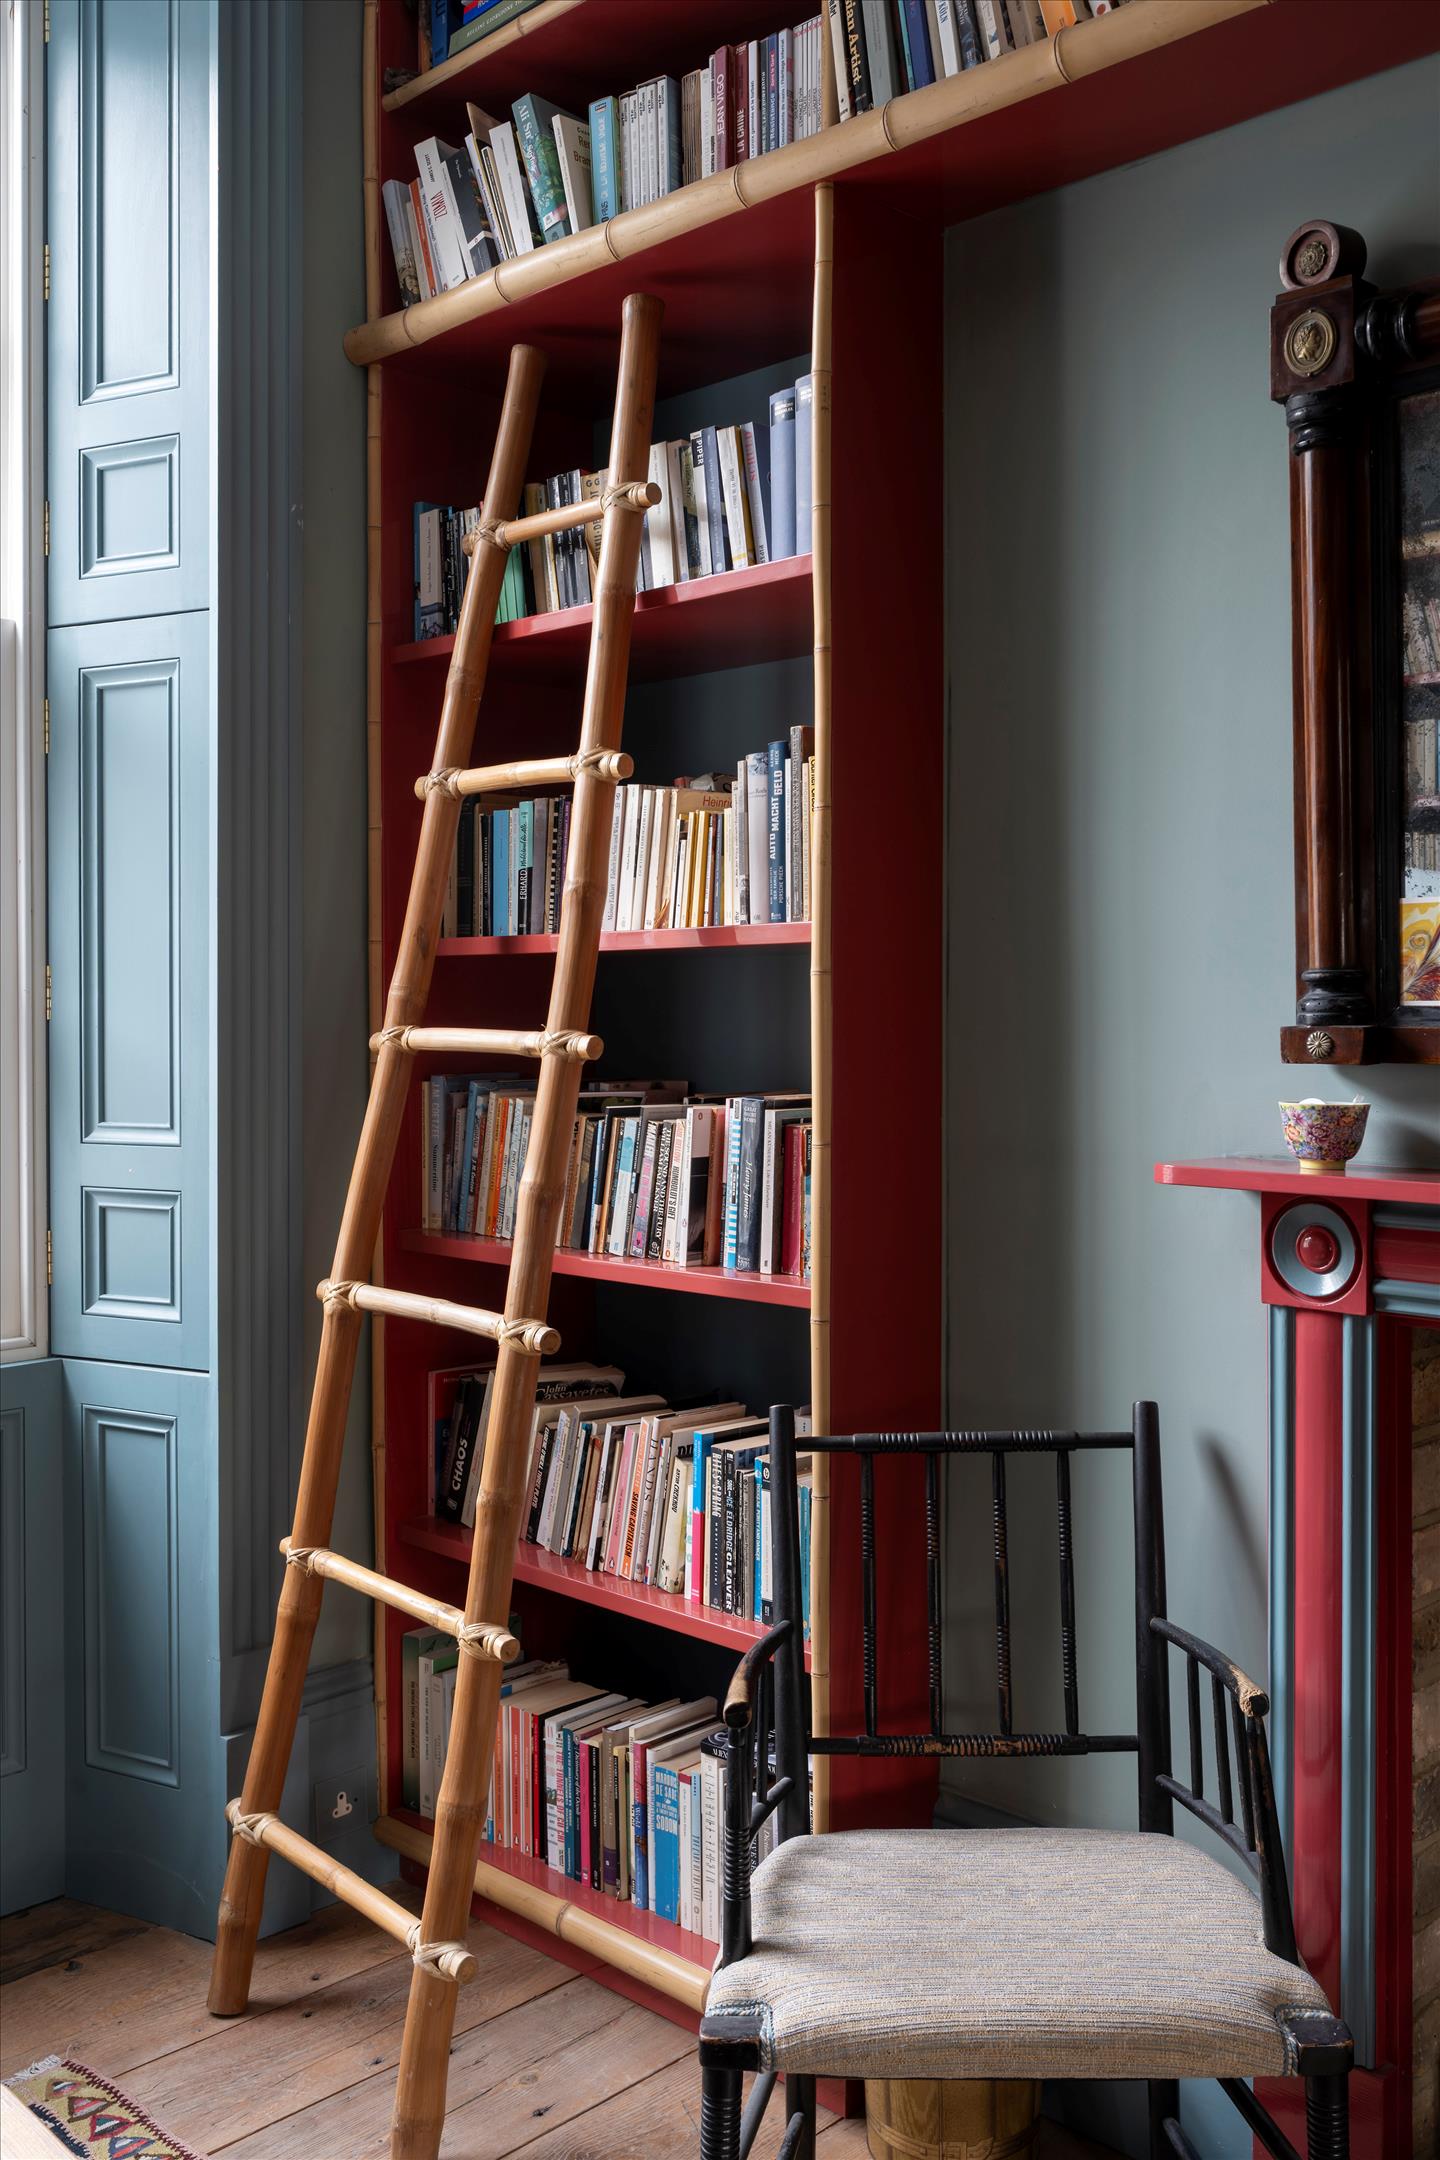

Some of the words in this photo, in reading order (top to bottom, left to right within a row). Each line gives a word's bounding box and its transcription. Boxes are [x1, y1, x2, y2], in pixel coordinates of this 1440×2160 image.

[849, 34, 862, 86] Artist
[518, 104, 529, 121] Ali
[717, 106, 725, 135] JEAN
[737, 108, 745, 139] CHINE
[737, 143, 745, 152] LA
[431, 191, 448, 221] ZOMIA
[773, 770, 783, 795] GELD
[770, 796, 779, 832] MACHT
[431, 1103, 439, 1140] COETZEE
[656, 1127, 667, 1166] WILLIAM
[664, 1128, 672, 1147] THE
[431, 1144, 439, 1193] Summertime
[661, 1148, 670, 1179] SOUND
[743, 1159, 753, 1191] Henry
[653, 1165, 663, 1213] FAULKNER
[659, 1179, 667, 1199] AND
[669, 1165, 679, 1206] HUMBOLDT'S
[667, 1206, 675, 1220] GIFT
[743, 1192, 752, 1219] James
[655, 1216, 664, 1240] FURY
[544, 1384, 567, 1394] John
[541, 1427, 550, 1450] EUGENE
[452, 1438, 468, 1491] CHAOS
[538, 1450, 547, 1470] O'NEILL
[644, 1438, 659, 1502] HANDS
[712, 1453, 721, 1479] RITES
[532, 1488, 540, 1508] PLAYS
[630, 1491, 639, 1517] SAVING
[671, 1484, 680, 1513] CHEKHOV
[711, 1484, 722, 1518] SPRING
[625, 1518, 637, 1557] CAPITALISM
[556, 1769, 564, 1802] TUNNELS
[557, 1817, 564, 1827] CU
[656, 1815, 677, 1836] SODOM
